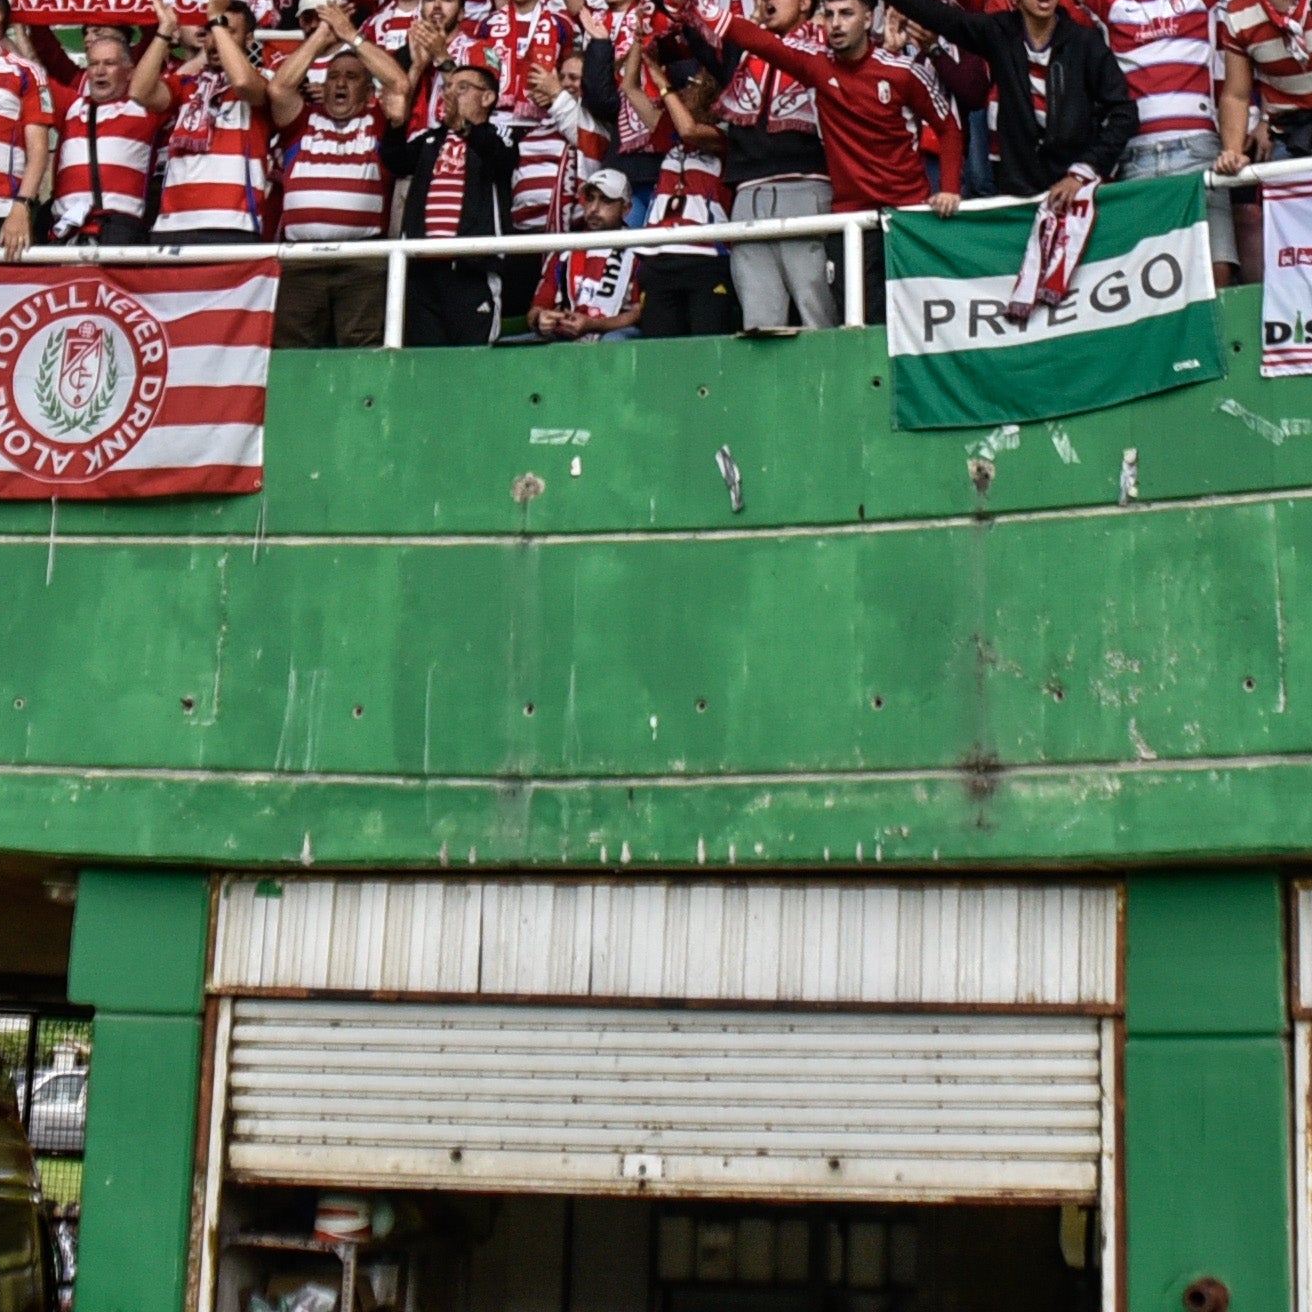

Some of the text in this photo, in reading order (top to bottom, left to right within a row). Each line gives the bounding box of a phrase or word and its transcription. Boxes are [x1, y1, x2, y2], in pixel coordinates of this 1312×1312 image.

[94, 284, 164, 366] NEVER
[923, 252, 1182, 343] PREGO
[82, 376, 163, 475] DRINK
